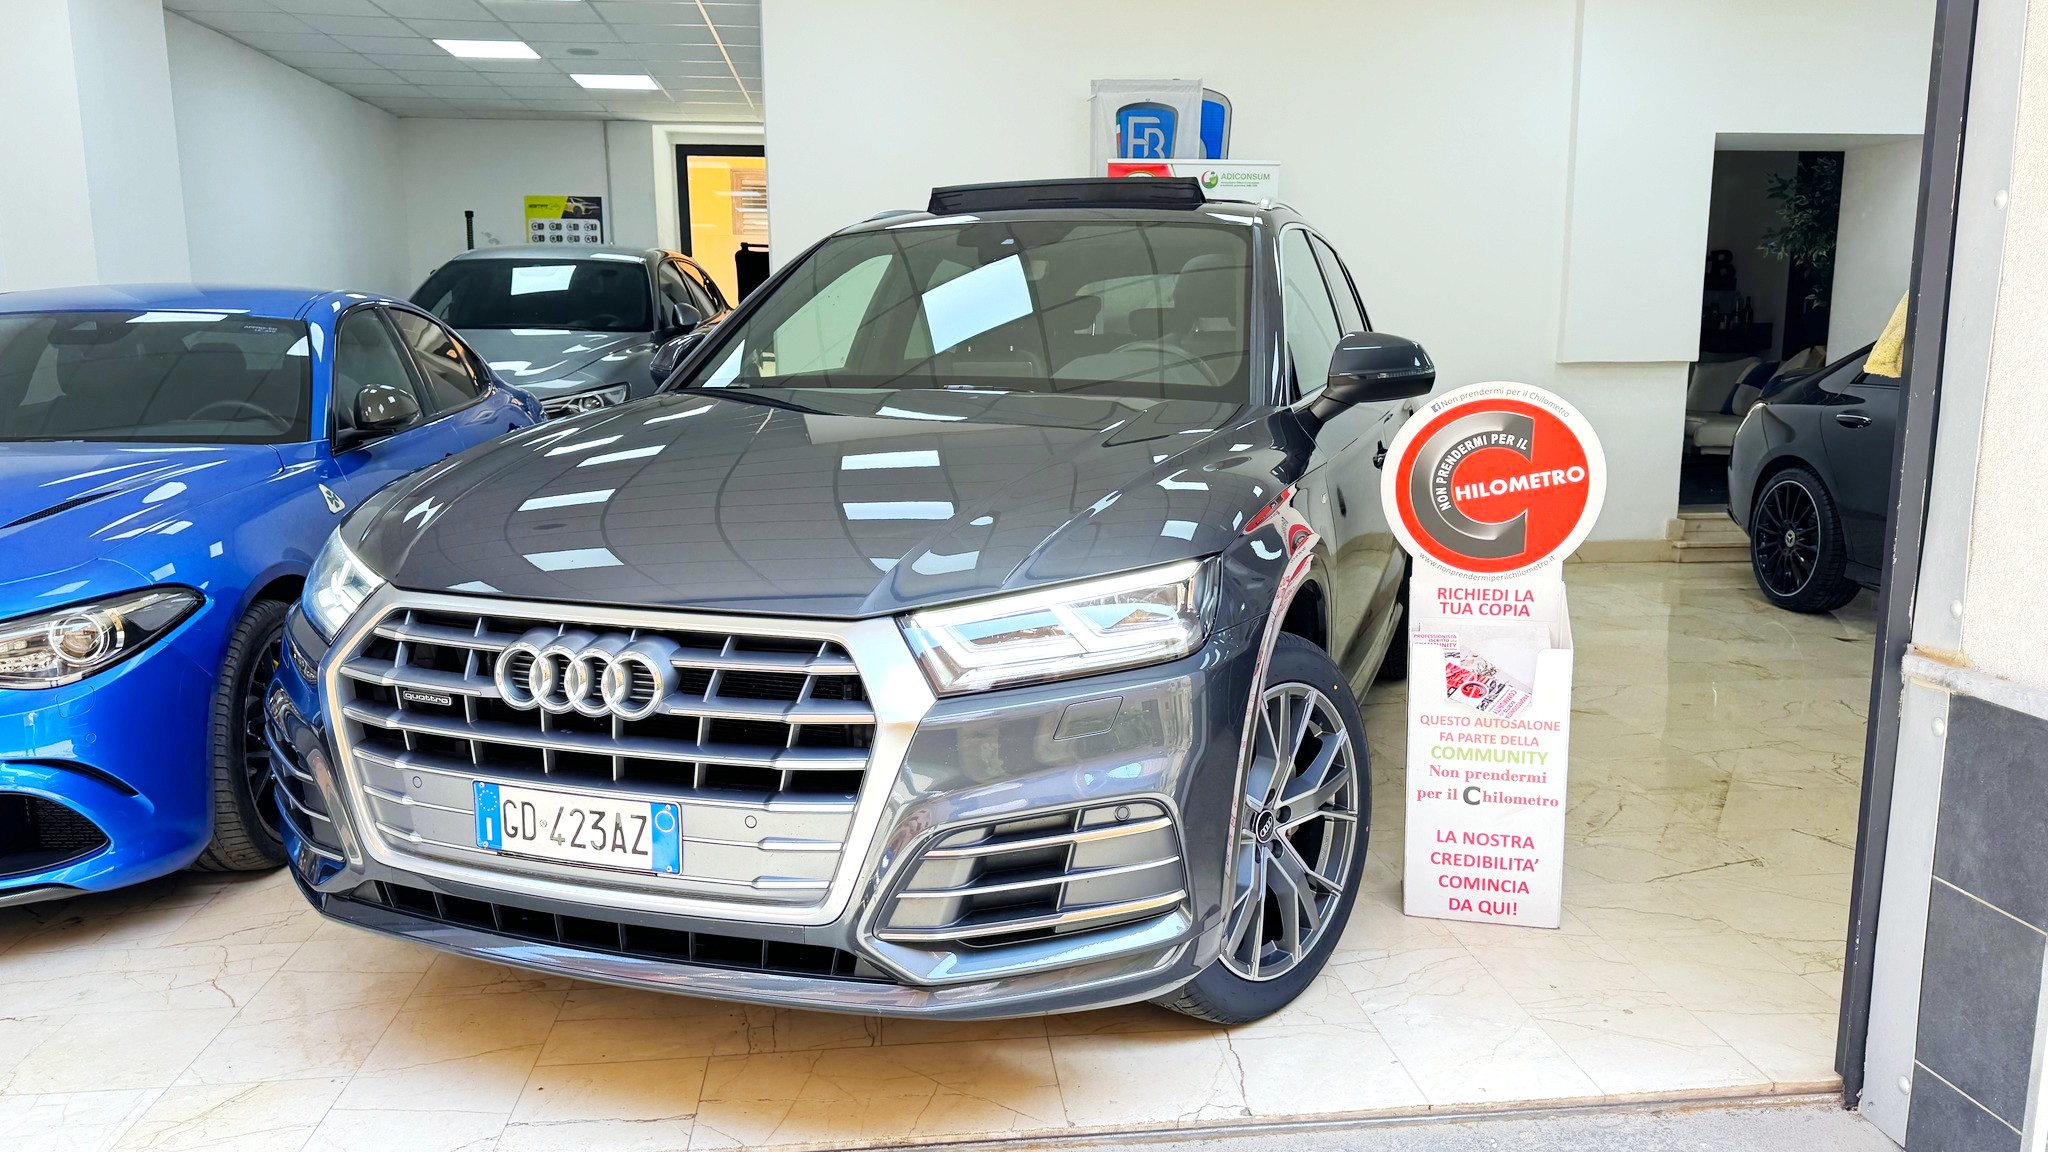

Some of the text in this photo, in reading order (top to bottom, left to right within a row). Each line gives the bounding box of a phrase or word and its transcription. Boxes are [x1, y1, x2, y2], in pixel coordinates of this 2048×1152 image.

[1220, 173, 1271, 181] ADICONSUM
[1440, 395, 1459, 408] Non
[1459, 386, 1505, 402] prendermi
[1506, 388, 1522, 398] per
[1522, 388, 1529, 398] il
[1529, 391, 1570, 418] Chilometro
[1434, 433, 1528, 512] NON PRENDERMI PER IL
[1418, 552, 1556, 582] www.nonprendermiperilchilometro.it
[1437, 587, 1535, 603] RICHIEDI LA
[1440, 602, 1531, 617] TUA COPIA
[404, 692, 449, 704] quattro
[1419, 714, 1561, 732] QUESTO AUTOSALONE
[1439, 731, 1540, 747] FA PARTE DELLA
[1430, 745, 1549, 766] COMMUNITY
[1429, 764, 1547, 784] Non prendermi
[1416, 785, 1560, 807] per il Chilometro
[1436, 829, 1535, 850] LA NOSTRA
[1438, 874, 1530, 895] COMINCIA
[1448, 897, 1518, 917] DA QUI!
